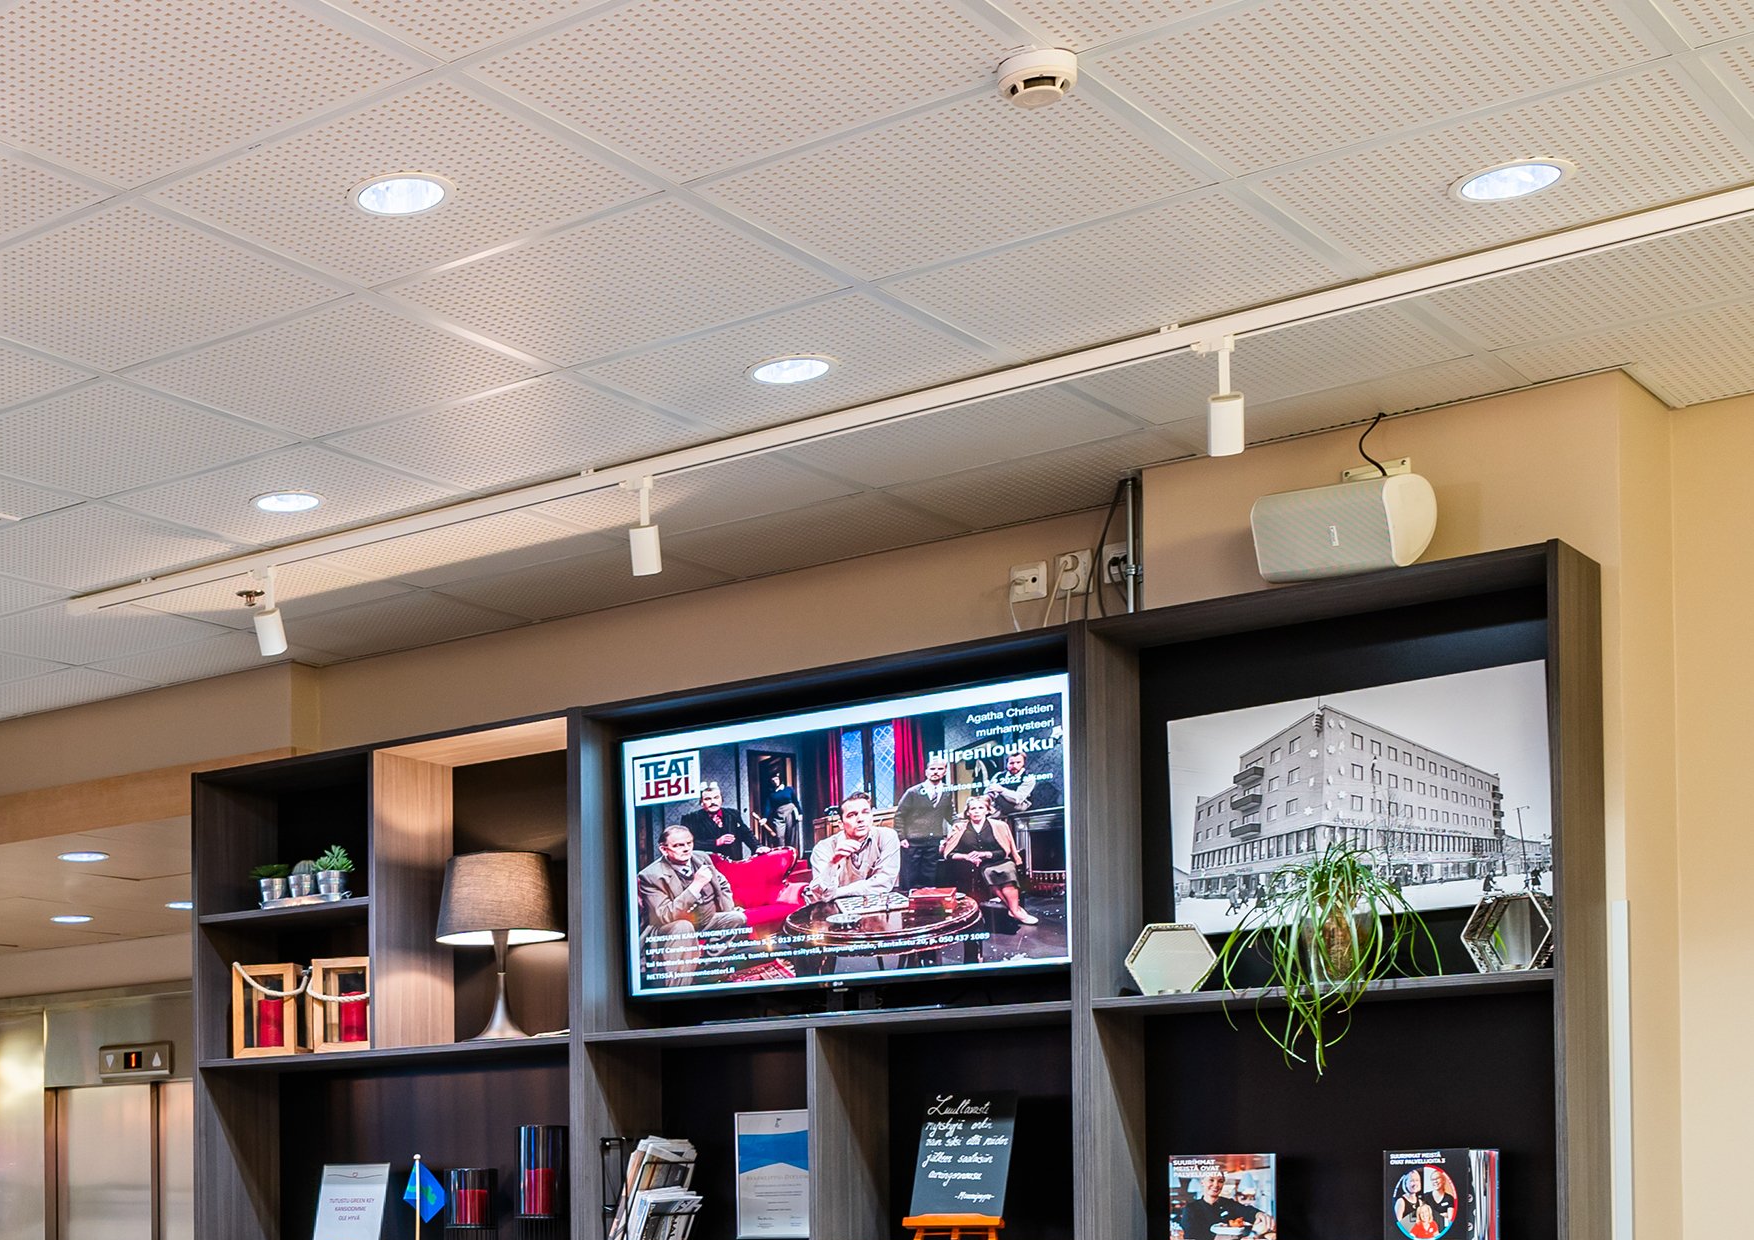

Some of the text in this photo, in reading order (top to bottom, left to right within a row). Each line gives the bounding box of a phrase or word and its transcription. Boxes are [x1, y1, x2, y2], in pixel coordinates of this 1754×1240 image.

[966, 703, 1054, 724] Agatha Christien
[975, 718, 1055, 737] murhamysteeri
[929, 736, 1055, 763] Hiirenloukku
[639, 756, 694, 781] TEAT
[131, 1053, 136, 1067] 1
